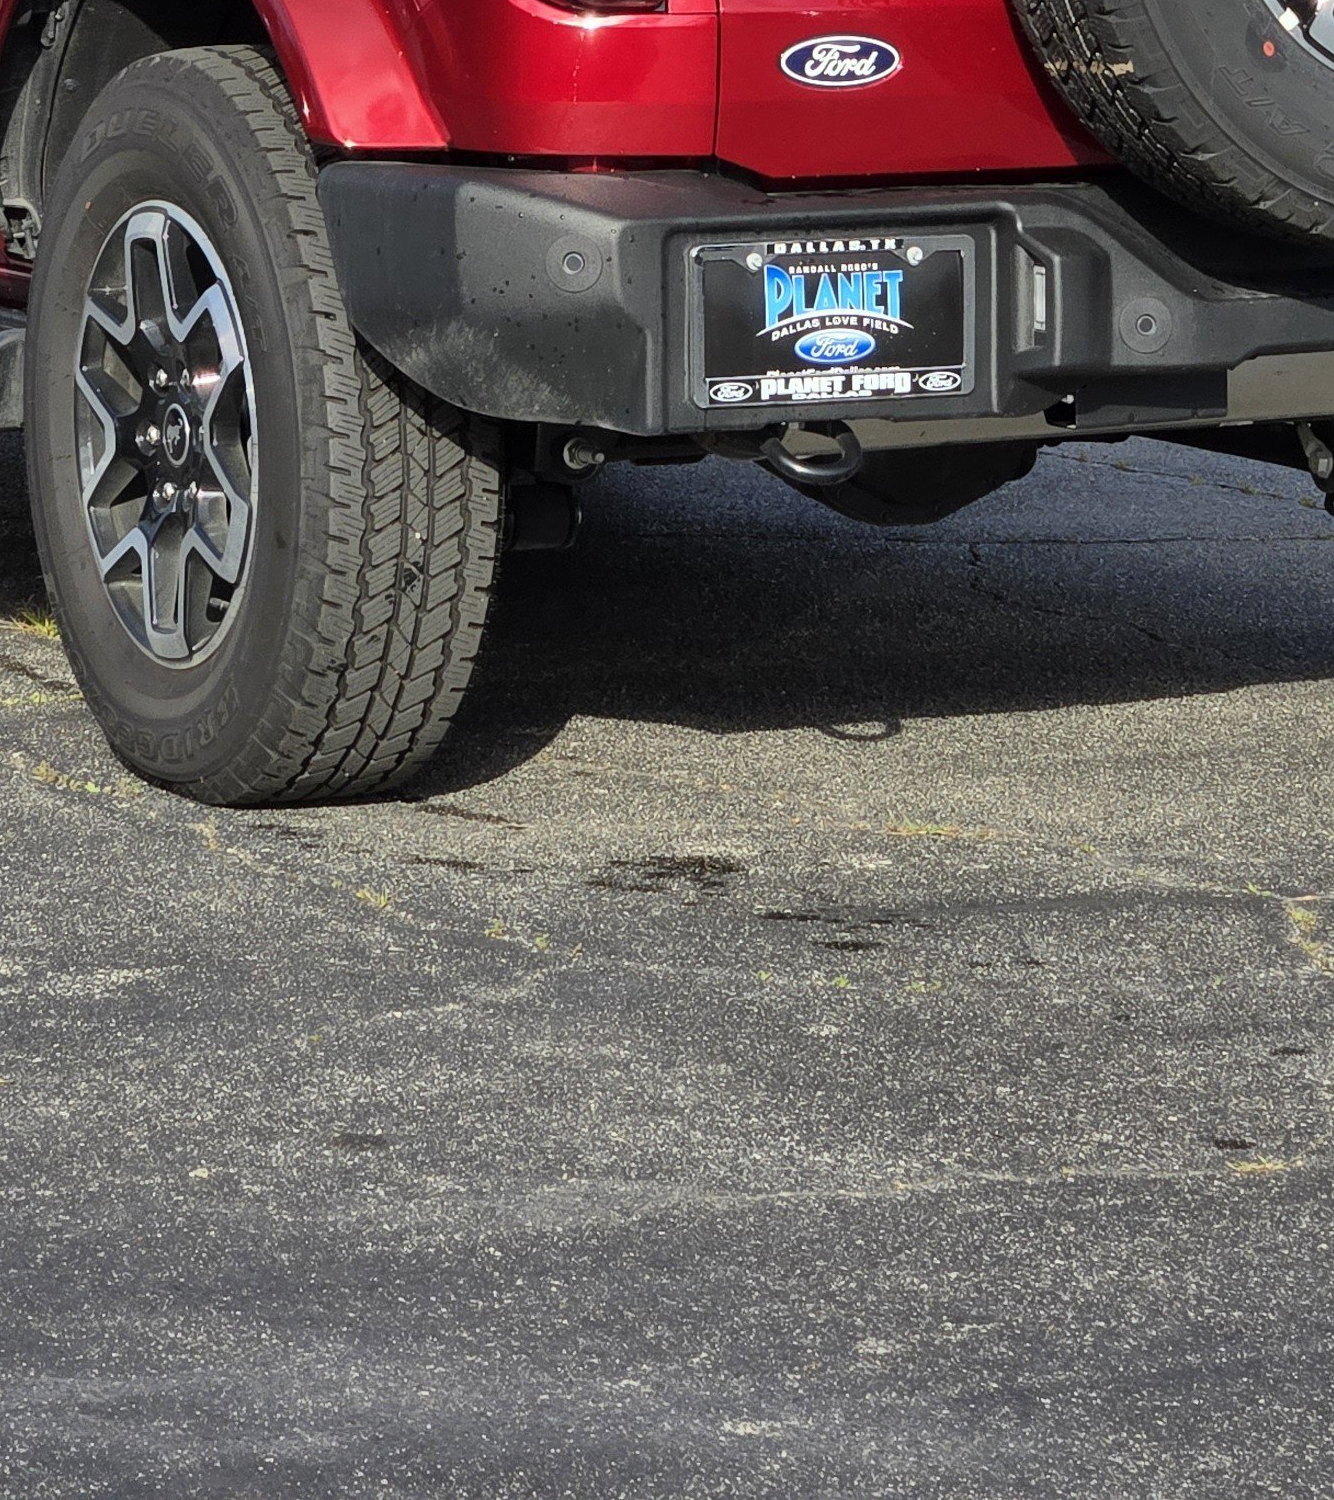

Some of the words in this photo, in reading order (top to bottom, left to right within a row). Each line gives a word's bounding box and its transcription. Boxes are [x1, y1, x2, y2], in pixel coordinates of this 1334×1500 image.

[804, 43, 879, 77] Ford
[788, 264, 837, 274] RANDALL
[764, 264, 903, 329] PLANET
[771, 318, 821, 341] DALLAS
[825, 315, 858, 326] LOVE
[862, 317, 900, 334] FIELD
[810, 333, 859, 358] Ford
[760, 374, 847, 400] PLANET
[851, 372, 912, 394] FORD
